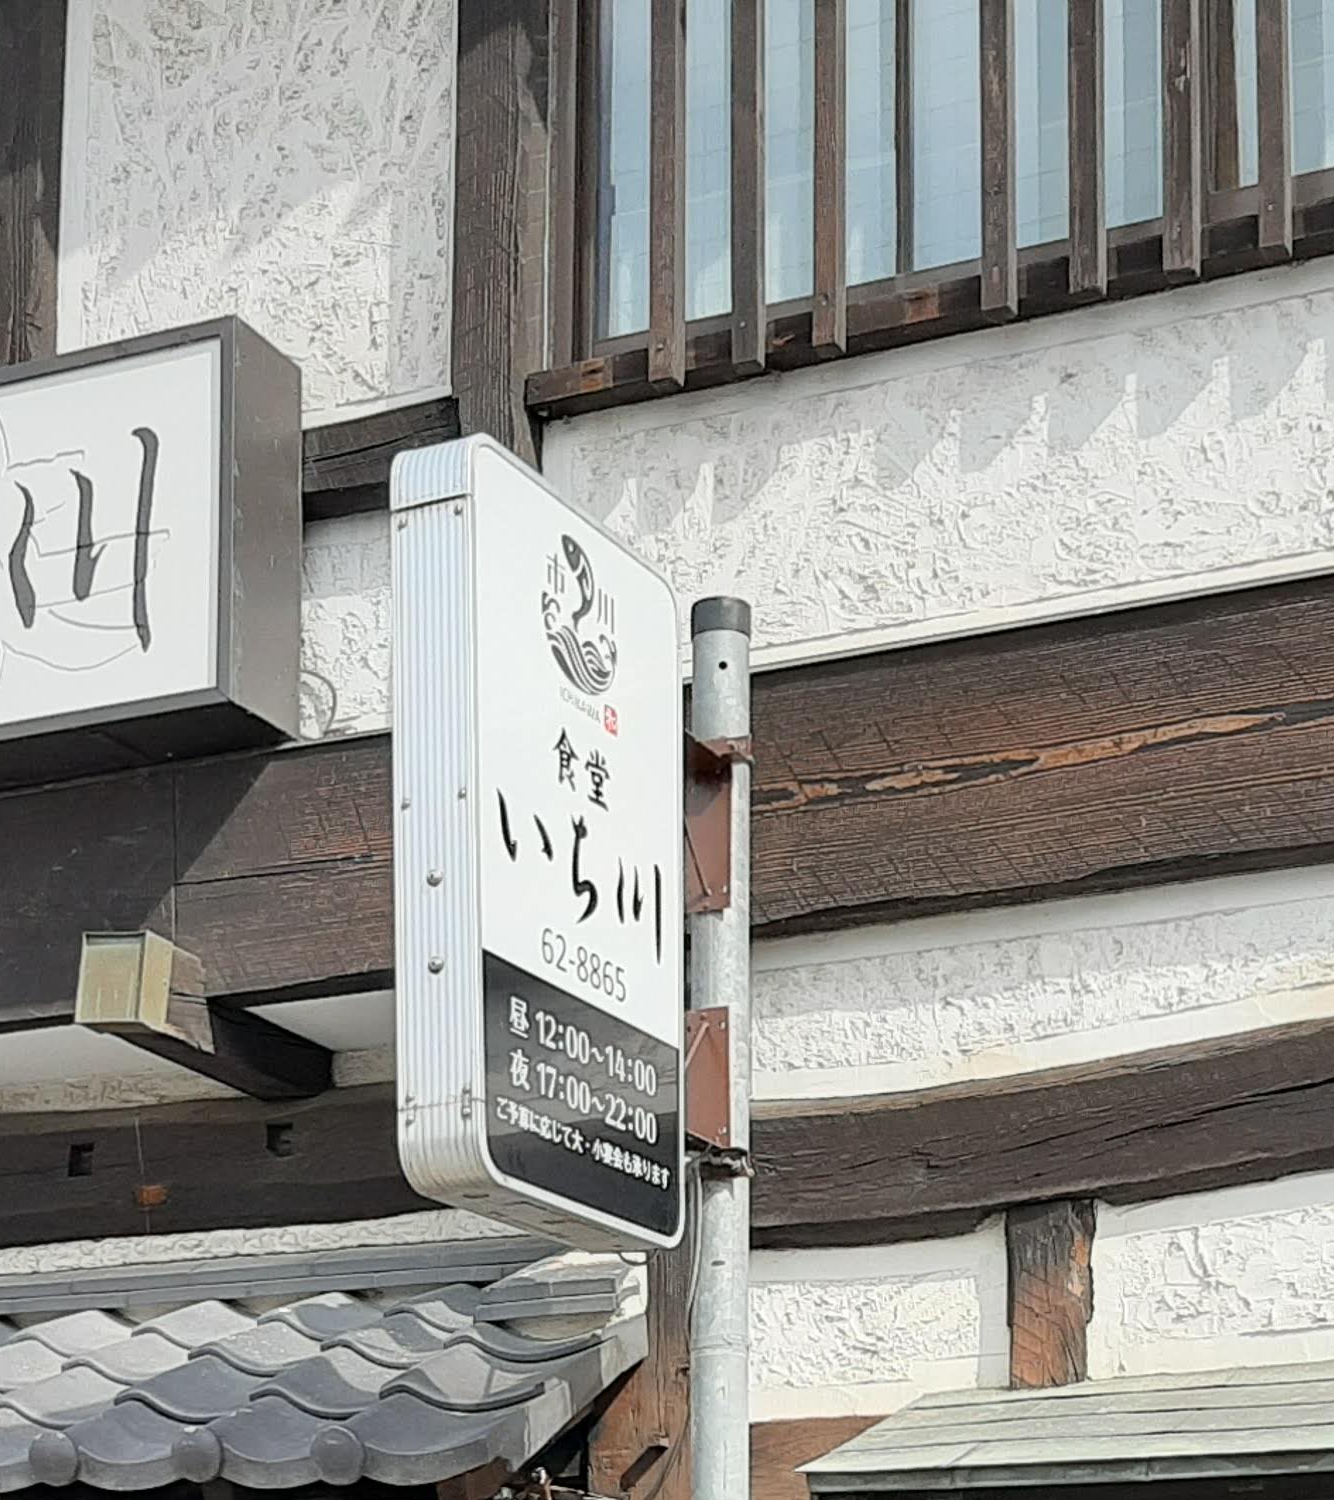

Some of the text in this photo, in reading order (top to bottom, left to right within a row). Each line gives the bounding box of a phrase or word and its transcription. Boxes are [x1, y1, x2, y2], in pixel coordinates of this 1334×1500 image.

[552, 727, 611, 812] 食堂
[496, 788, 662, 966] いち川
[541, 928, 627, 1002] 62-8865
[509, 1049, 530, 1092] 夜
